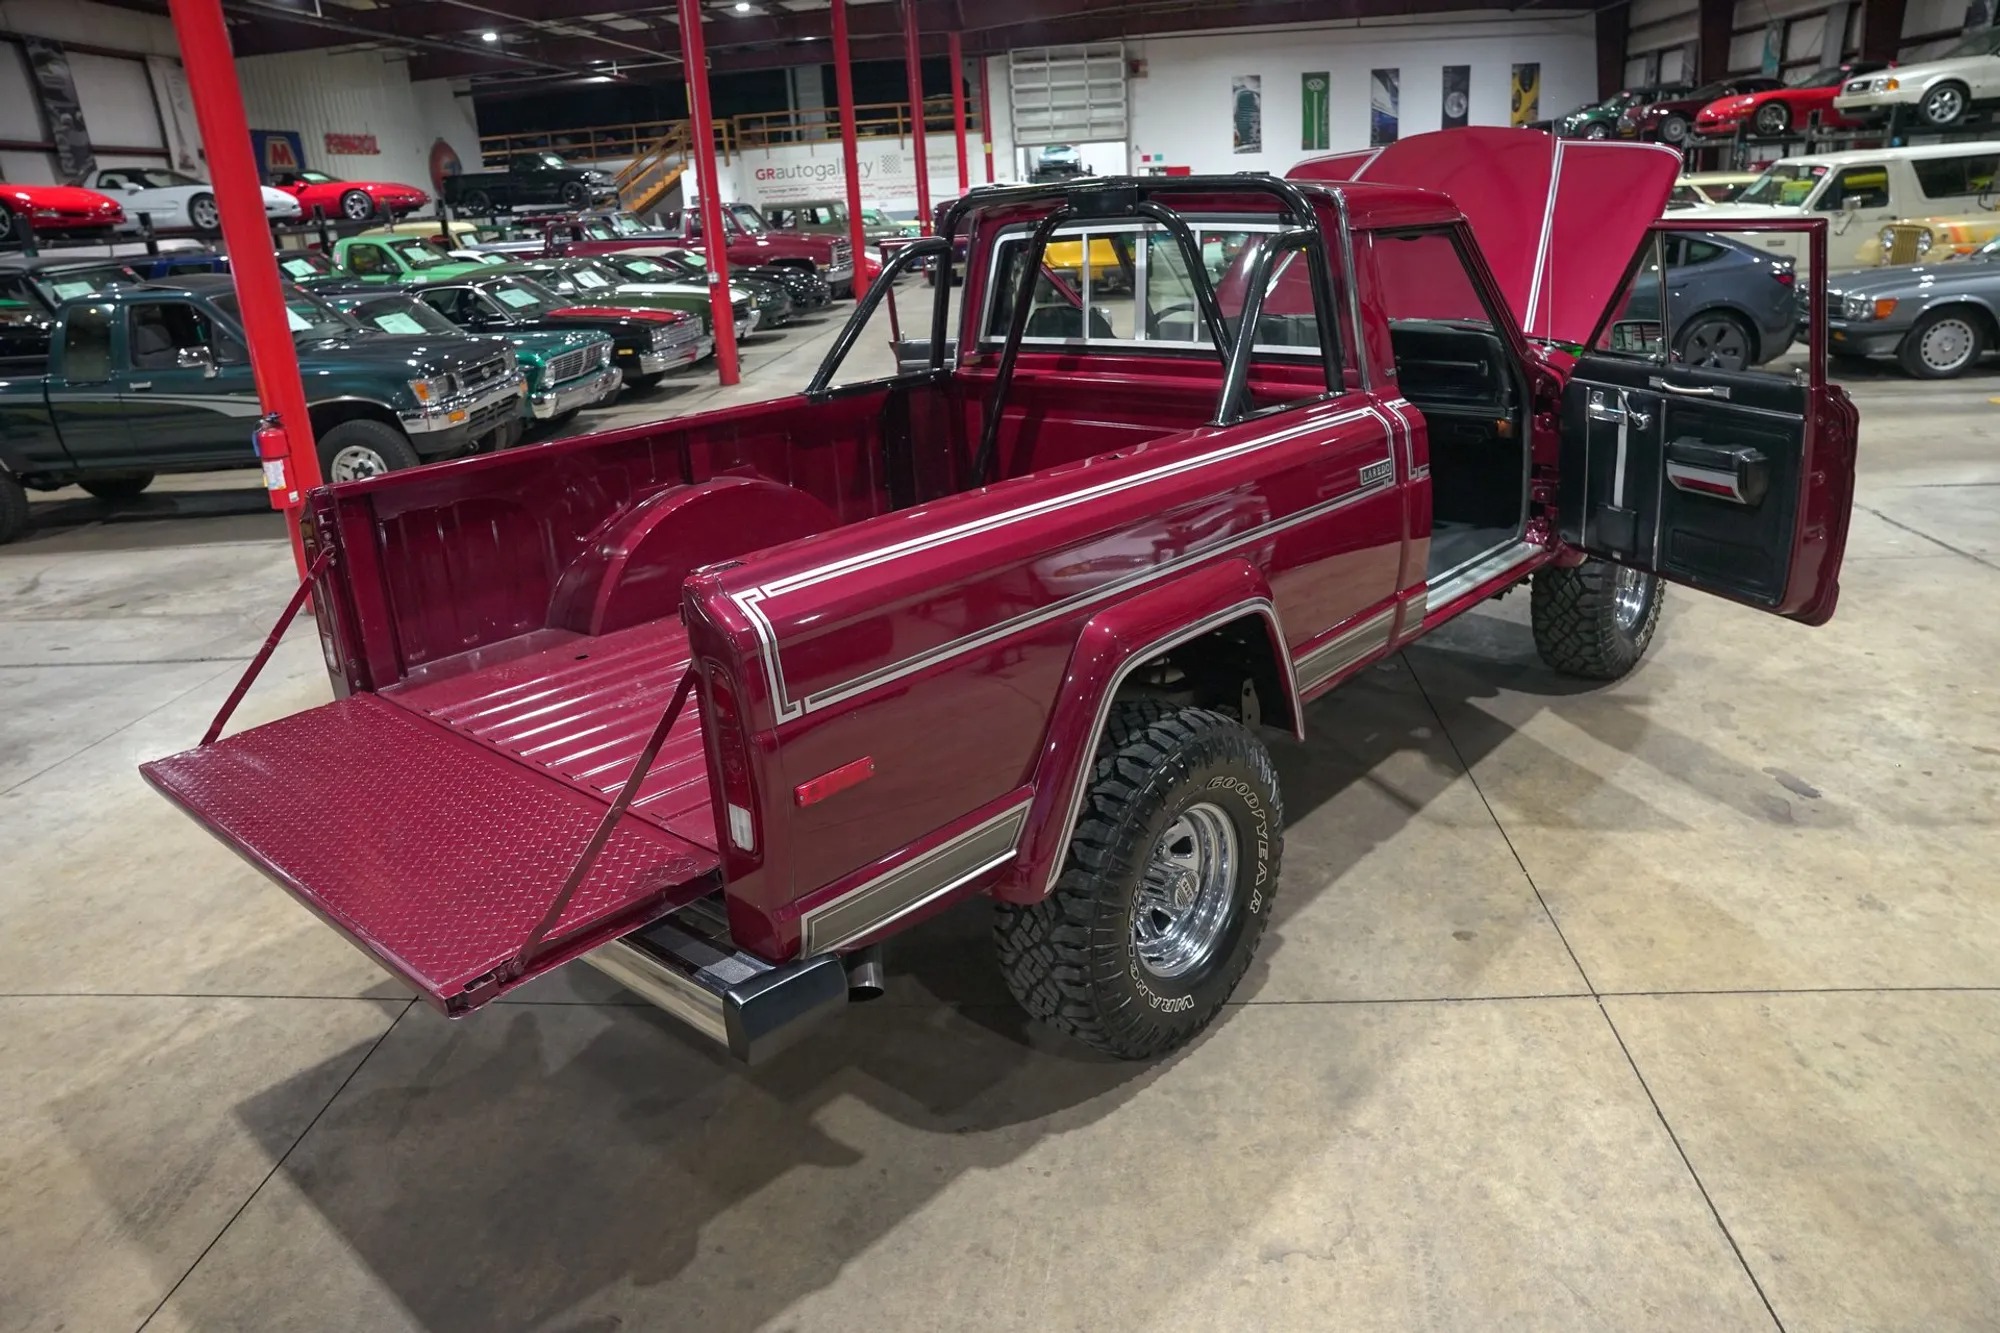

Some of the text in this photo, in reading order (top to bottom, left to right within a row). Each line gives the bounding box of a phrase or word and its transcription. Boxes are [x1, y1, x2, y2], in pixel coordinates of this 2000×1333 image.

[271, 143, 294, 165] M
[1363, 463, 1391, 481] LAREDO
[1207, 776, 1269, 914] GOODYEAR
